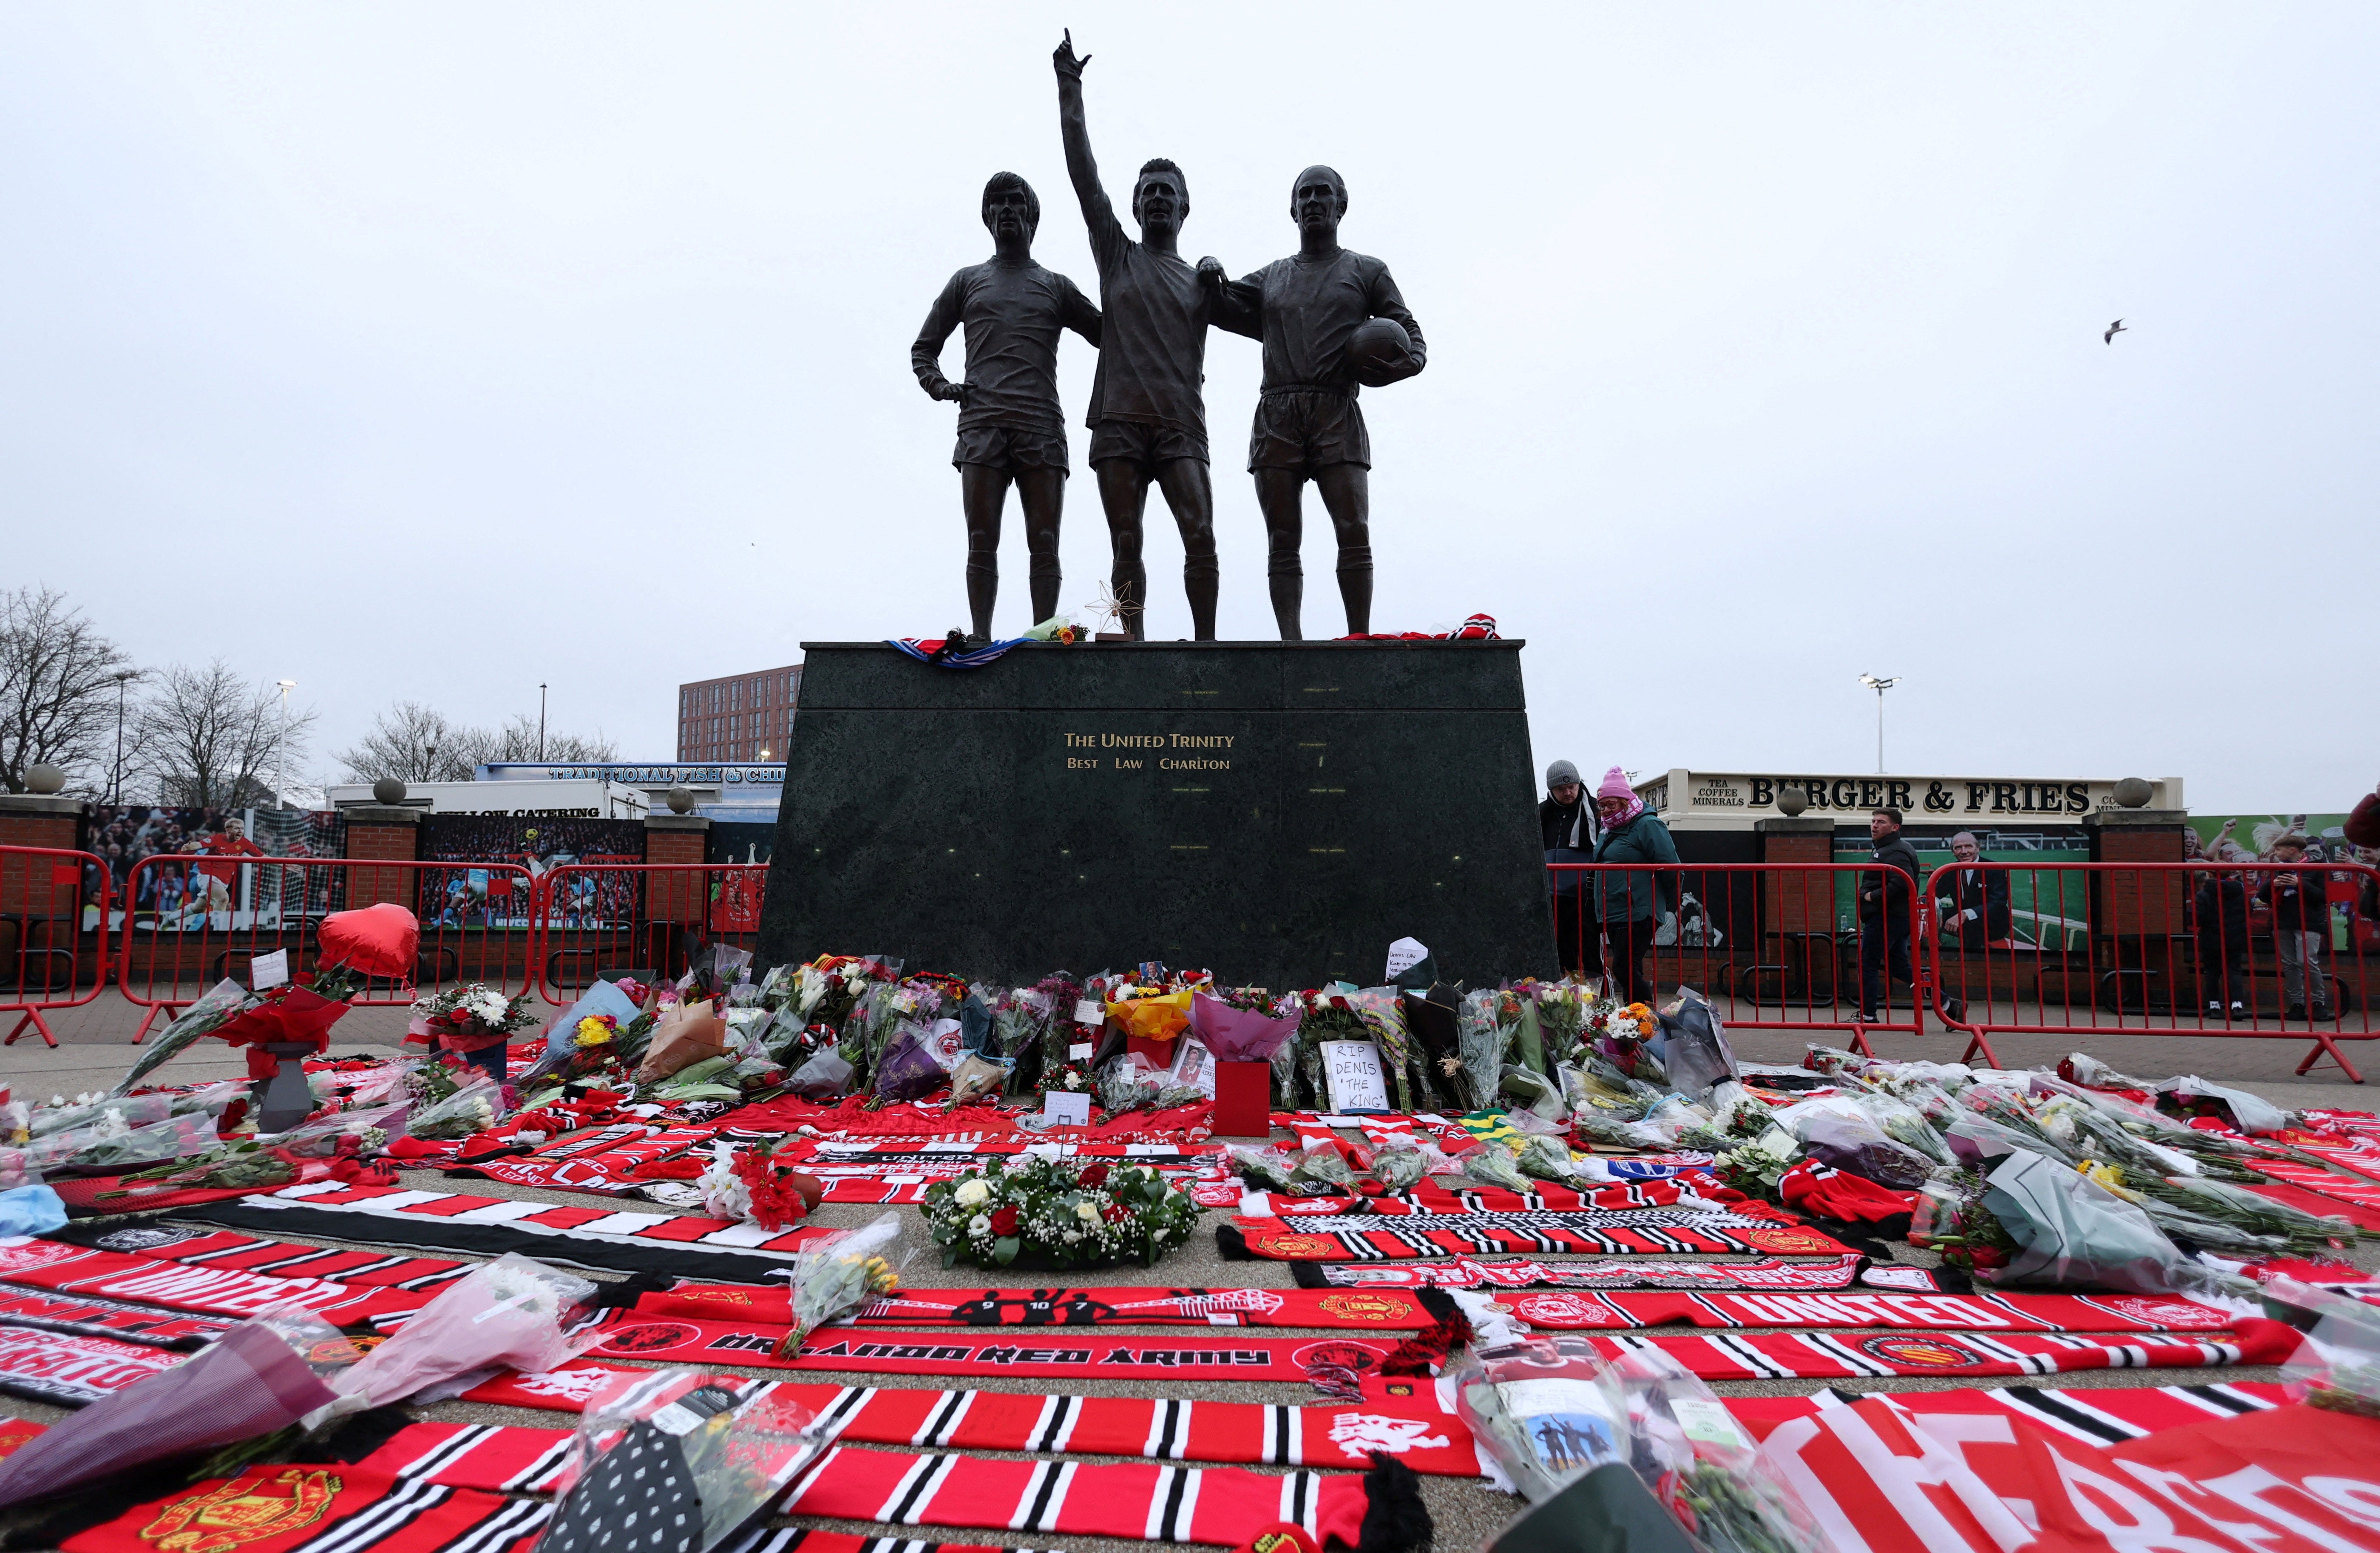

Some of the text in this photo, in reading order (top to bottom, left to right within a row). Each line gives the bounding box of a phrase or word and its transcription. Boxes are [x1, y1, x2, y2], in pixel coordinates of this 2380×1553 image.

[550, 767, 672, 783] TRADITIONAL
[677, 767, 721, 782] FISH
[726, 767, 741, 782] &
[1709, 779, 1728, 788] TEA
[1698, 788, 1738, 797] COFFEE
[1923, 781, 1955, 811] &
[1964, 781, 2091, 814] FRIES
[1693, 798, 1744, 806] MINERALS
[513, 808, 600, 818] CATERING
[1337, 1046, 1365, 1057] RIP
[1336, 1062, 1376, 1075] DENIS
[1384, 1216, 1673, 1229] MANCHESTER UNITED
[100, 1265, 348, 1312] UNITED
[982, 1301, 995, 1311] 9
[1030, 1301, 1050, 1311] 10
[1075, 1301, 1088, 1310] 7
[1725, 1294, 2011, 1327] UNITED
[974, 1345, 1092, 1365] RED
[1098, 1346, 1271, 1367] ARMY
